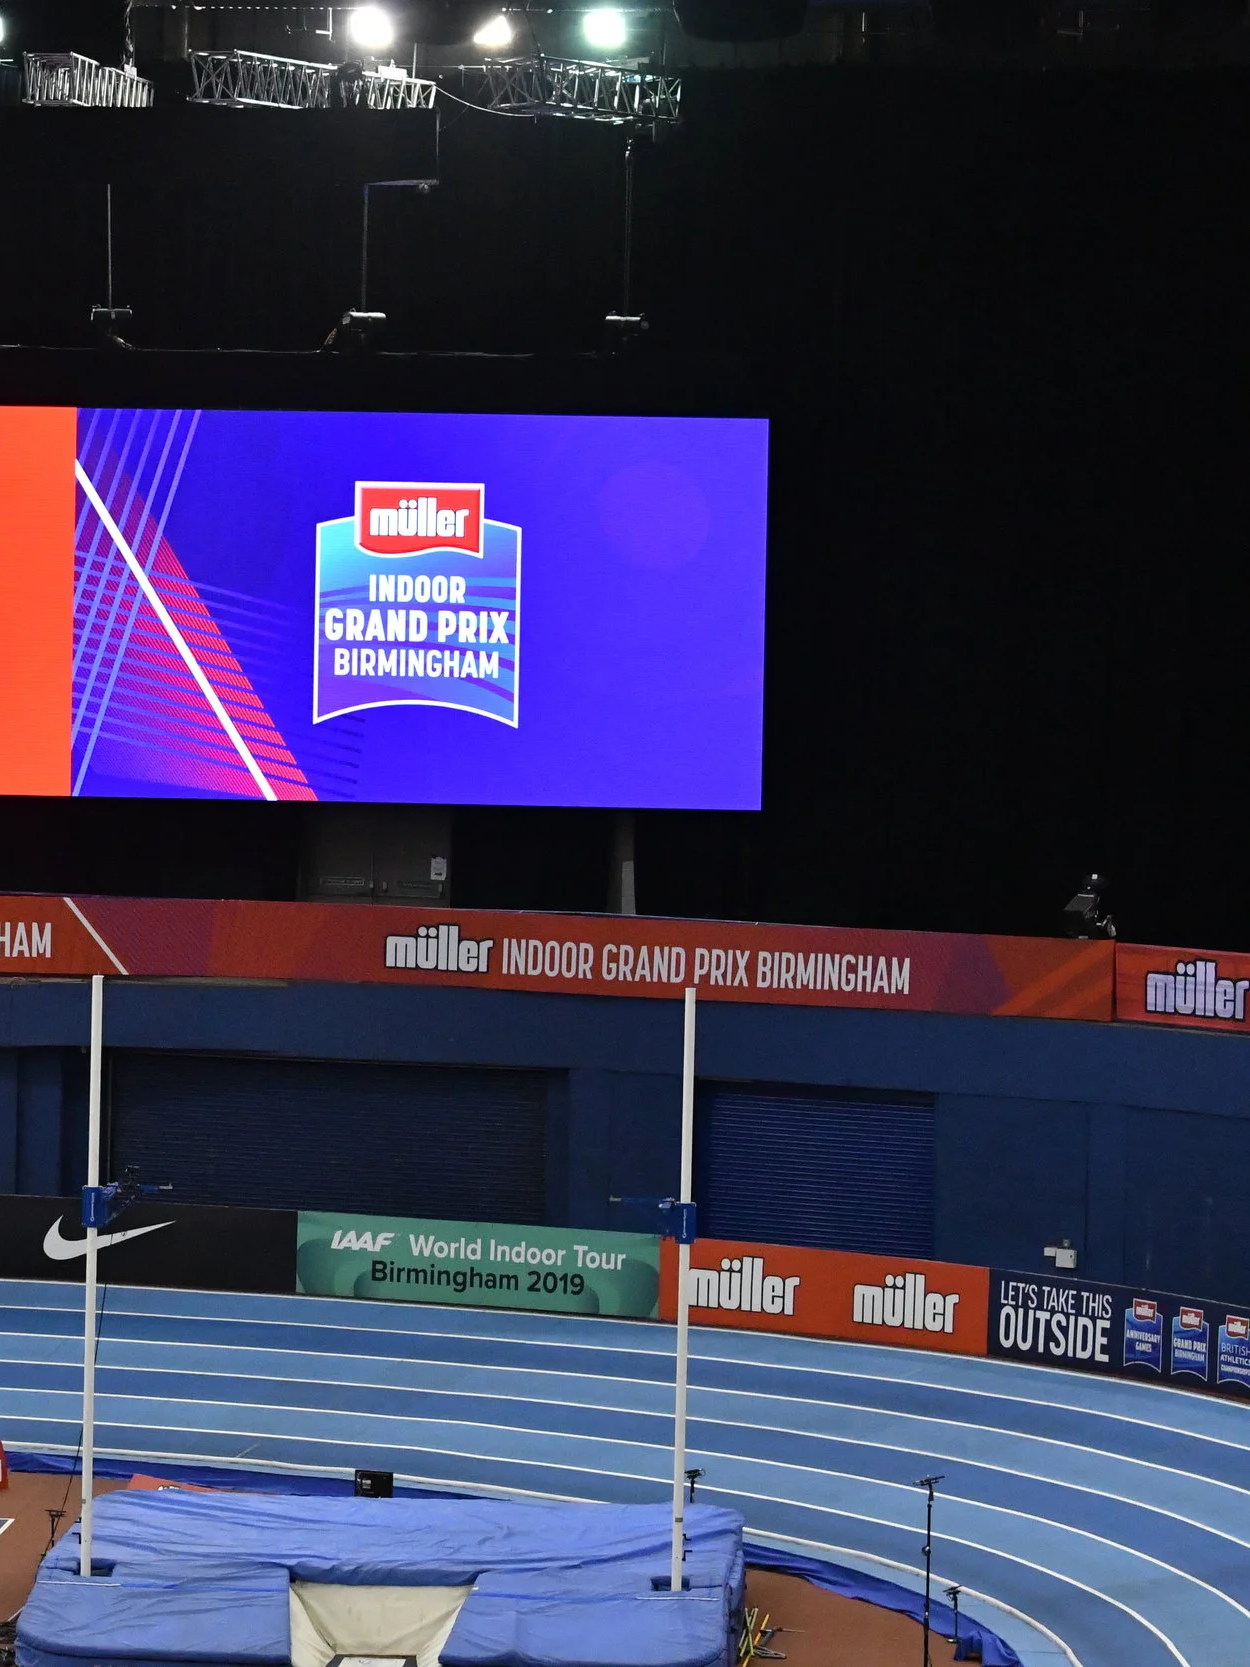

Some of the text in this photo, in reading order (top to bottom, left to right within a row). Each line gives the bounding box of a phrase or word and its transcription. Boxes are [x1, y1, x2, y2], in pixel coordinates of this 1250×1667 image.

[369, 496, 470, 538] müller
[368, 573, 467, 604] INDOOR
[323, 607, 510, 644] GRAND PRIX
[333, 647, 499, 679] BIRMINGHAM
[385, 924, 911, 996] müller INDOOR GRAND PRIX BIRMINGHAM
[1145, 960, 1250, 1021] müller
[330, 1229, 627, 1271] IAAF World Indoor Tour
[370, 1259, 585, 1296] Birmingham 2019
[688, 1256, 801, 1317] müller
[853, 1273, 960, 1335] müller
[1000, 1280, 1112, 1319] LET'S TAKE THIS
[999, 1305, 1111, 1363] OUTSIDE
[1126, 1329, 1160, 1344] ANNIVERSARY
[1135, 1342, 1152, 1353] GAMES
[1173, 1338, 1207, 1351] GRAND PRIX
[1174, 1349, 1205, 1362] BIRMINGHAM
